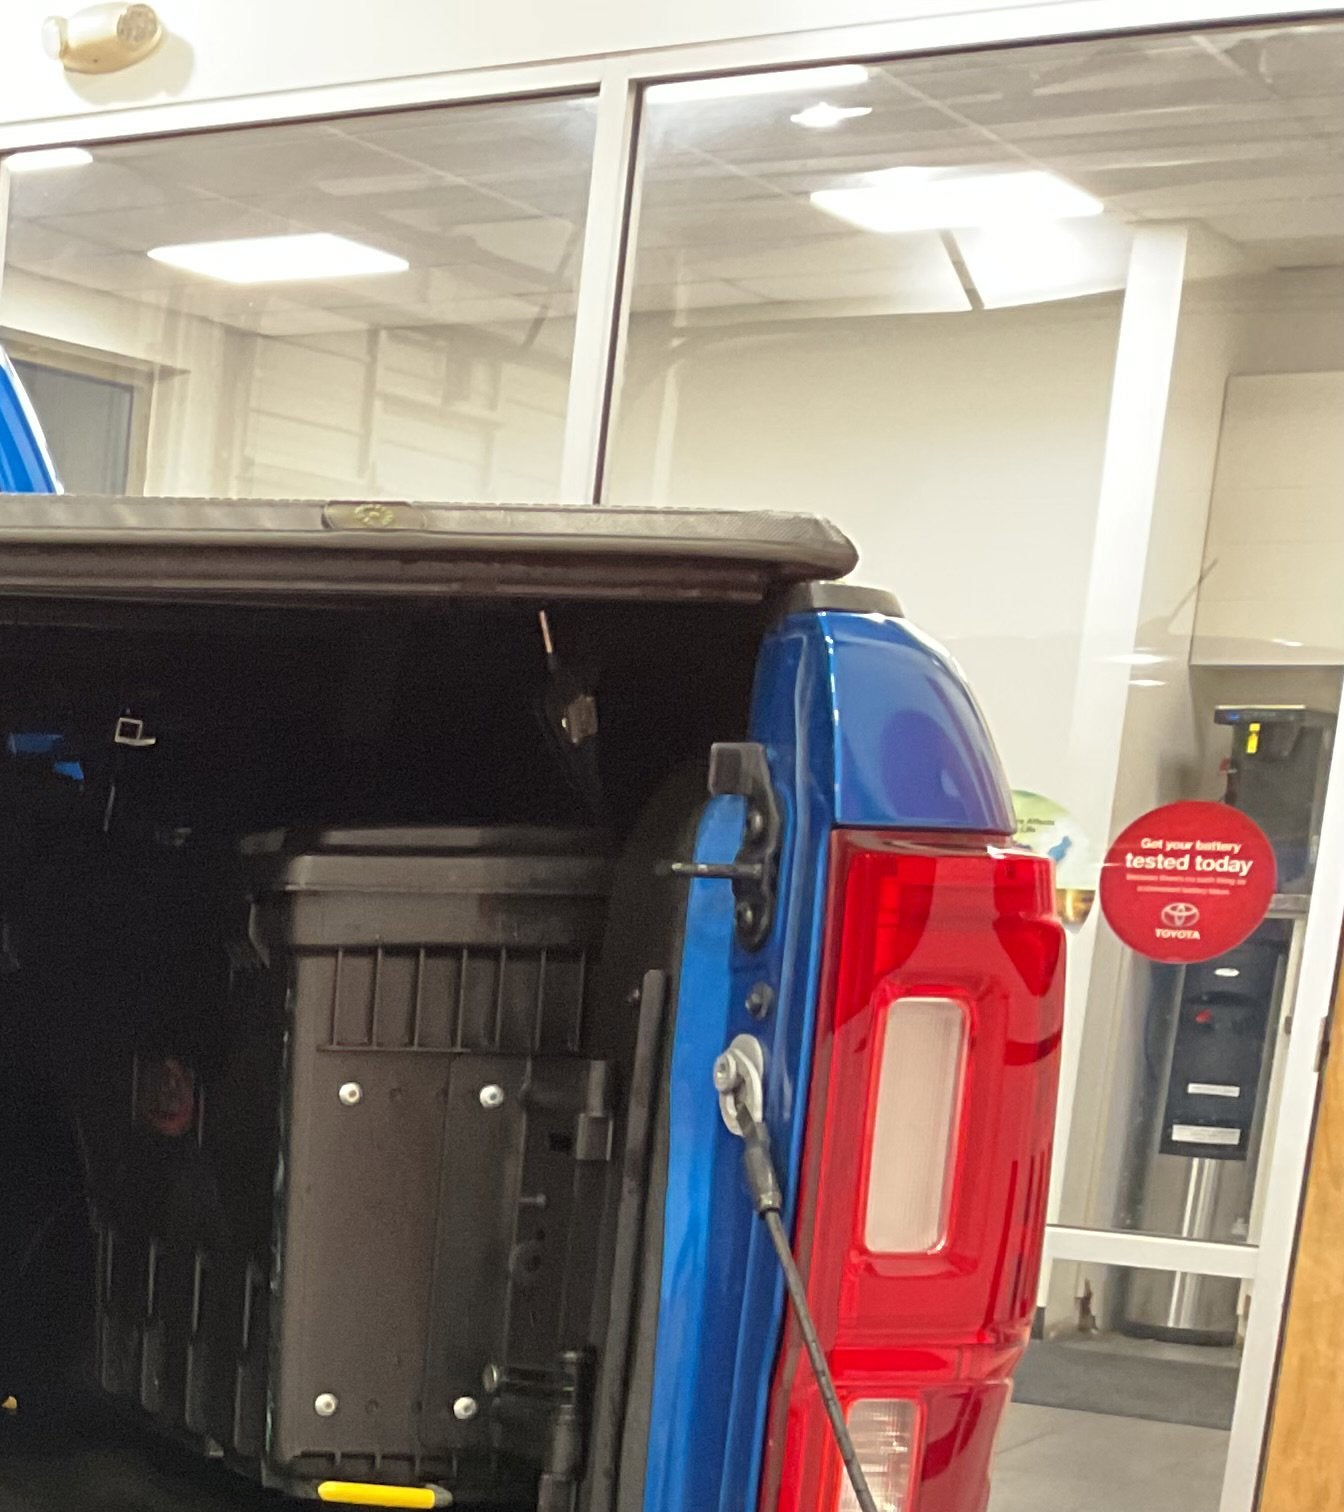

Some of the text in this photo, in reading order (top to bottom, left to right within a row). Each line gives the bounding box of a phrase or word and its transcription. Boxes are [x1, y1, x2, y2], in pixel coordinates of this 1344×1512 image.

[1140, 837, 1242, 854] Get your battery
[1125, 852, 1253, 877] tested today
[1155, 928, 1201, 940] TOYOTA
